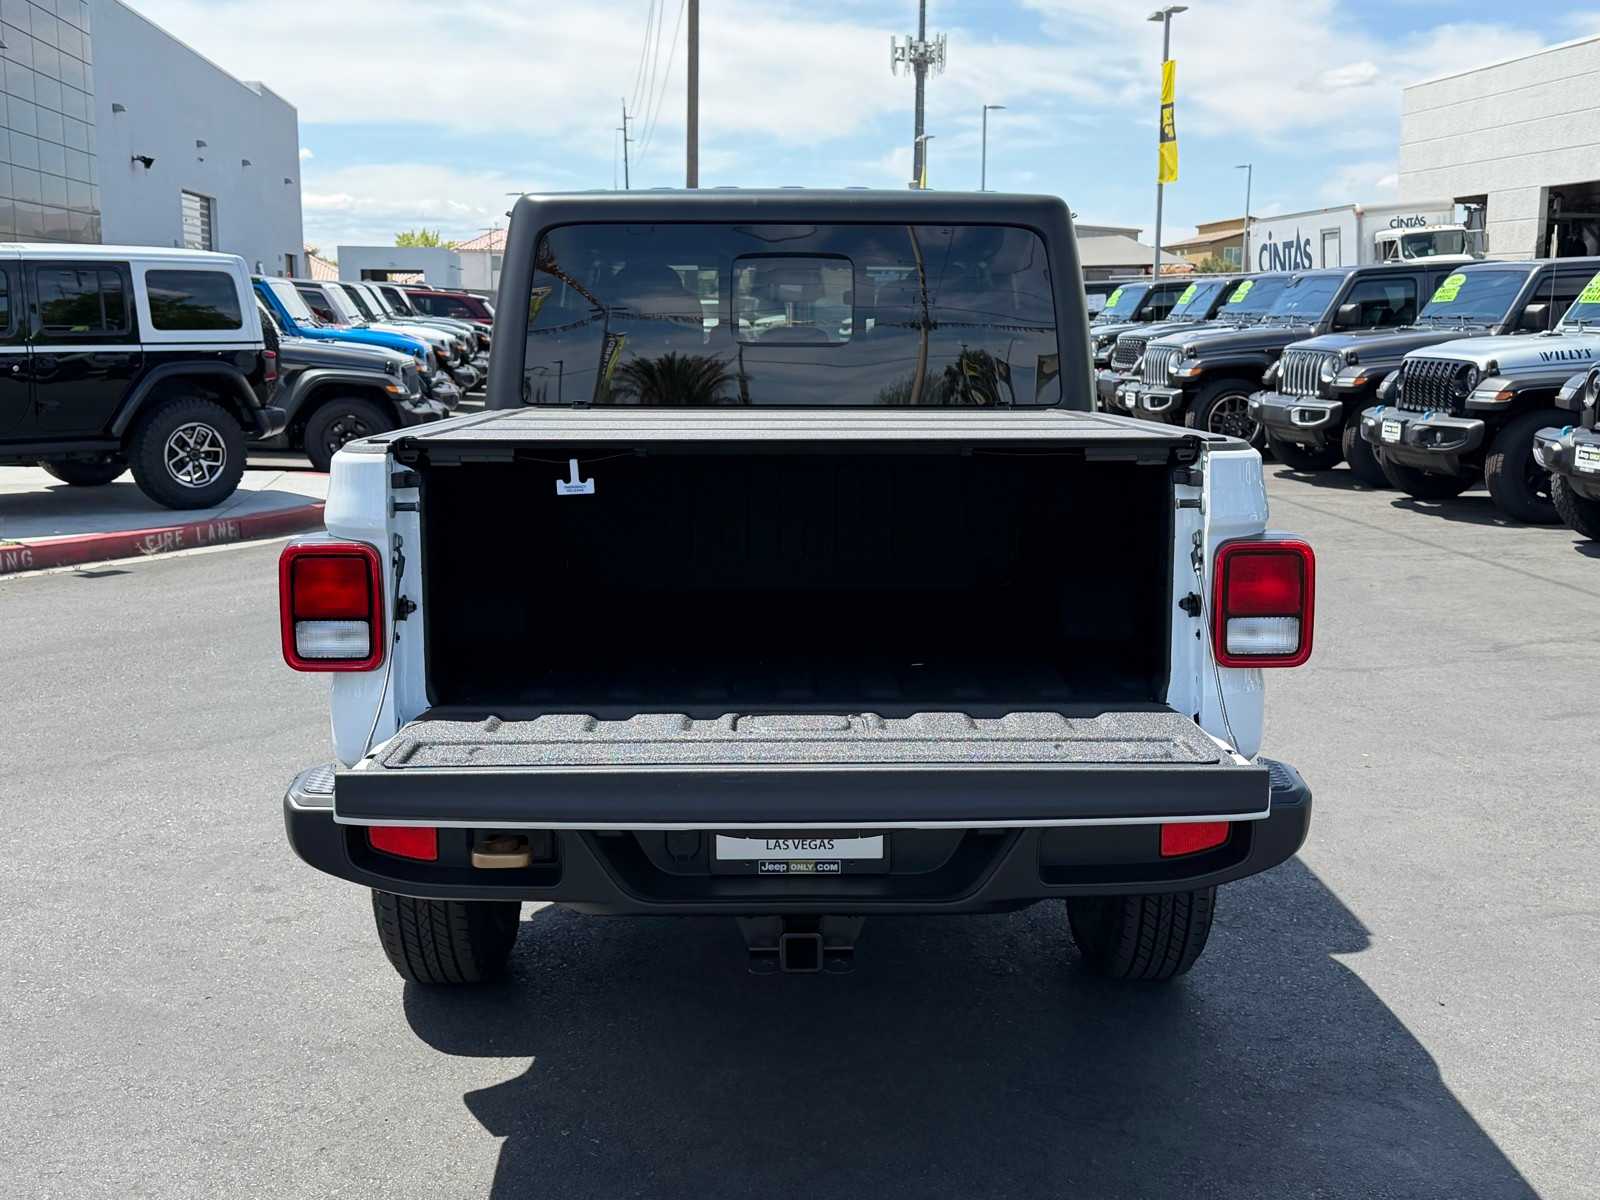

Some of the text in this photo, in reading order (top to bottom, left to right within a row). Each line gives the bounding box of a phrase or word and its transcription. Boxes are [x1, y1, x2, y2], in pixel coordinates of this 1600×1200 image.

[1389, 214, 1426, 229] CINTAS
[1259, 227, 1313, 272] CINTAS
[144, 521, 238, 551] FIRE LANE
[765, 839, 835, 850] LAS VEGAS
[761, 862, 787, 873] Jeep
